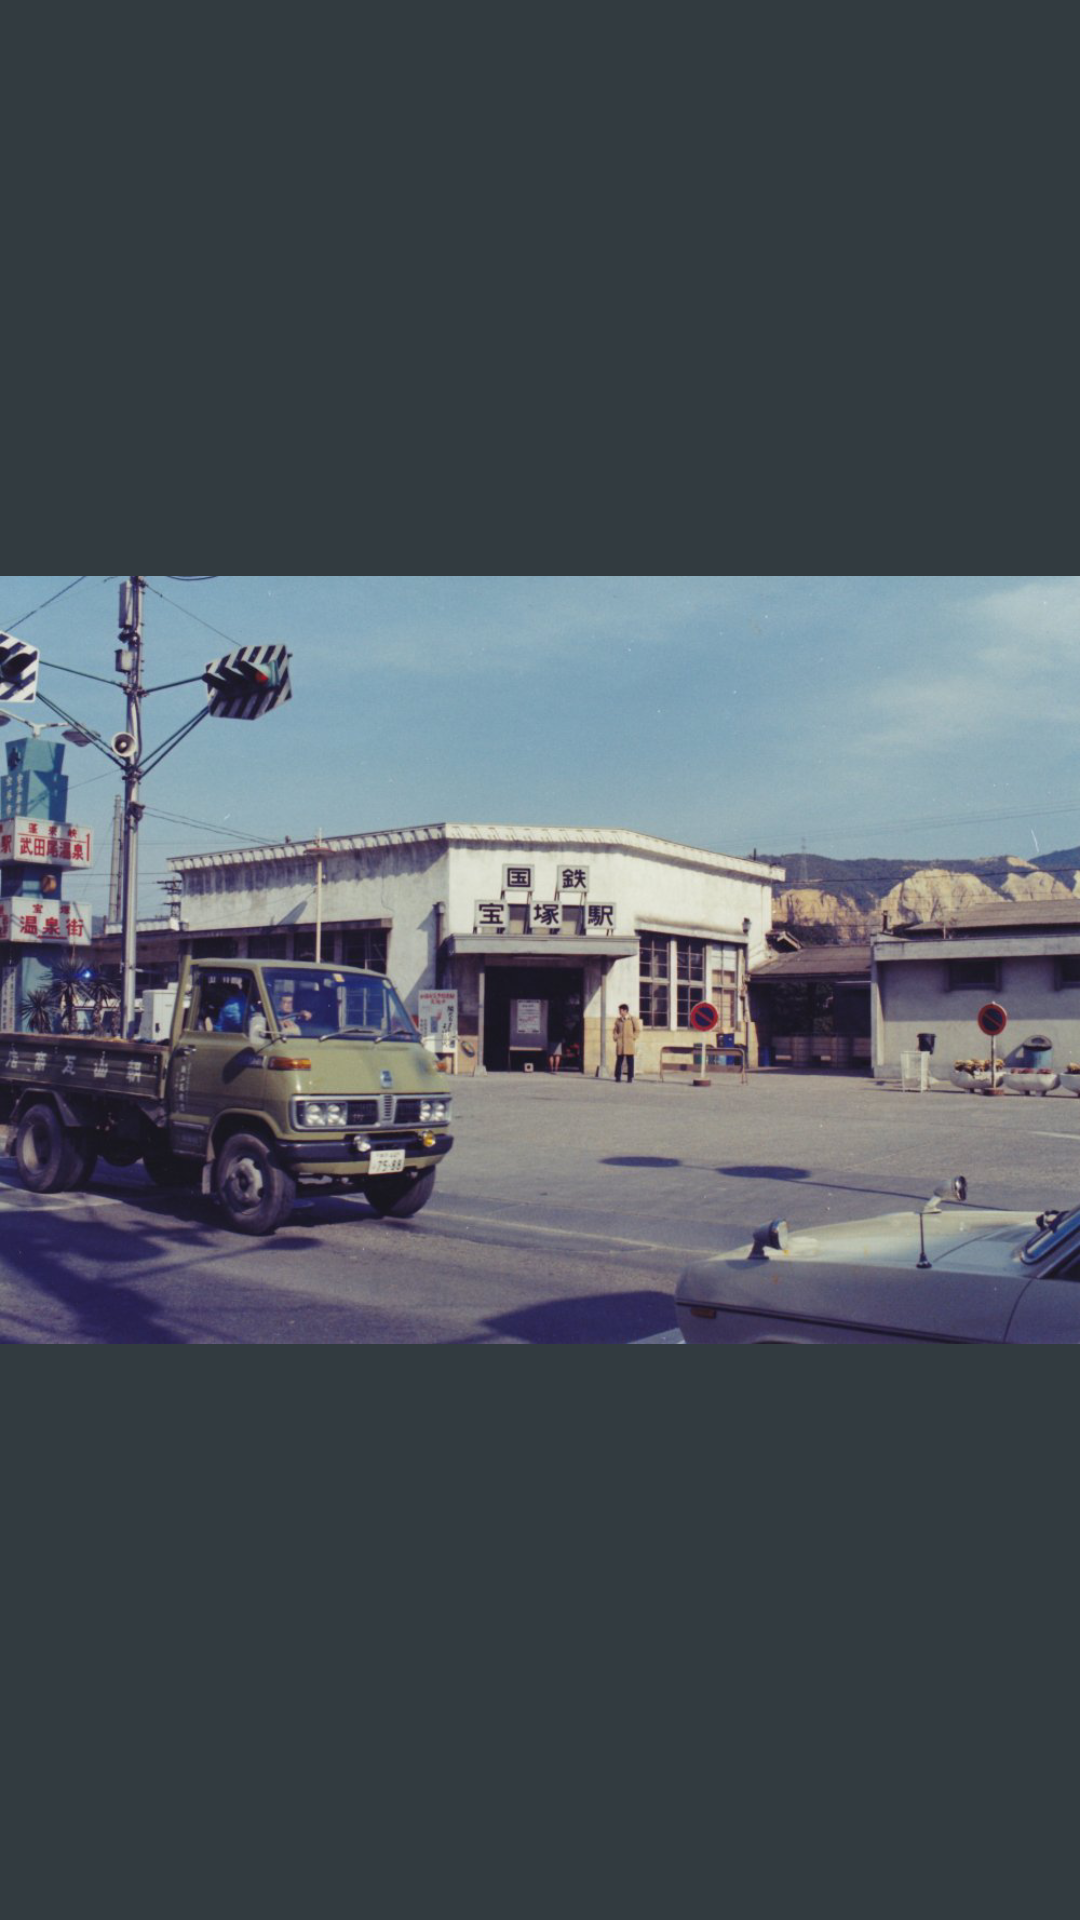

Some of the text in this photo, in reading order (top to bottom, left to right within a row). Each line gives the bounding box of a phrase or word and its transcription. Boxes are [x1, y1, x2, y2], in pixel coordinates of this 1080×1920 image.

[20, 837, 84, 860] 武田尾温泉
[506, 867, 587, 889] 国鉄
[479, 902, 614, 926] 宝塚駅
[20, 915, 84, 937] 温泉街
